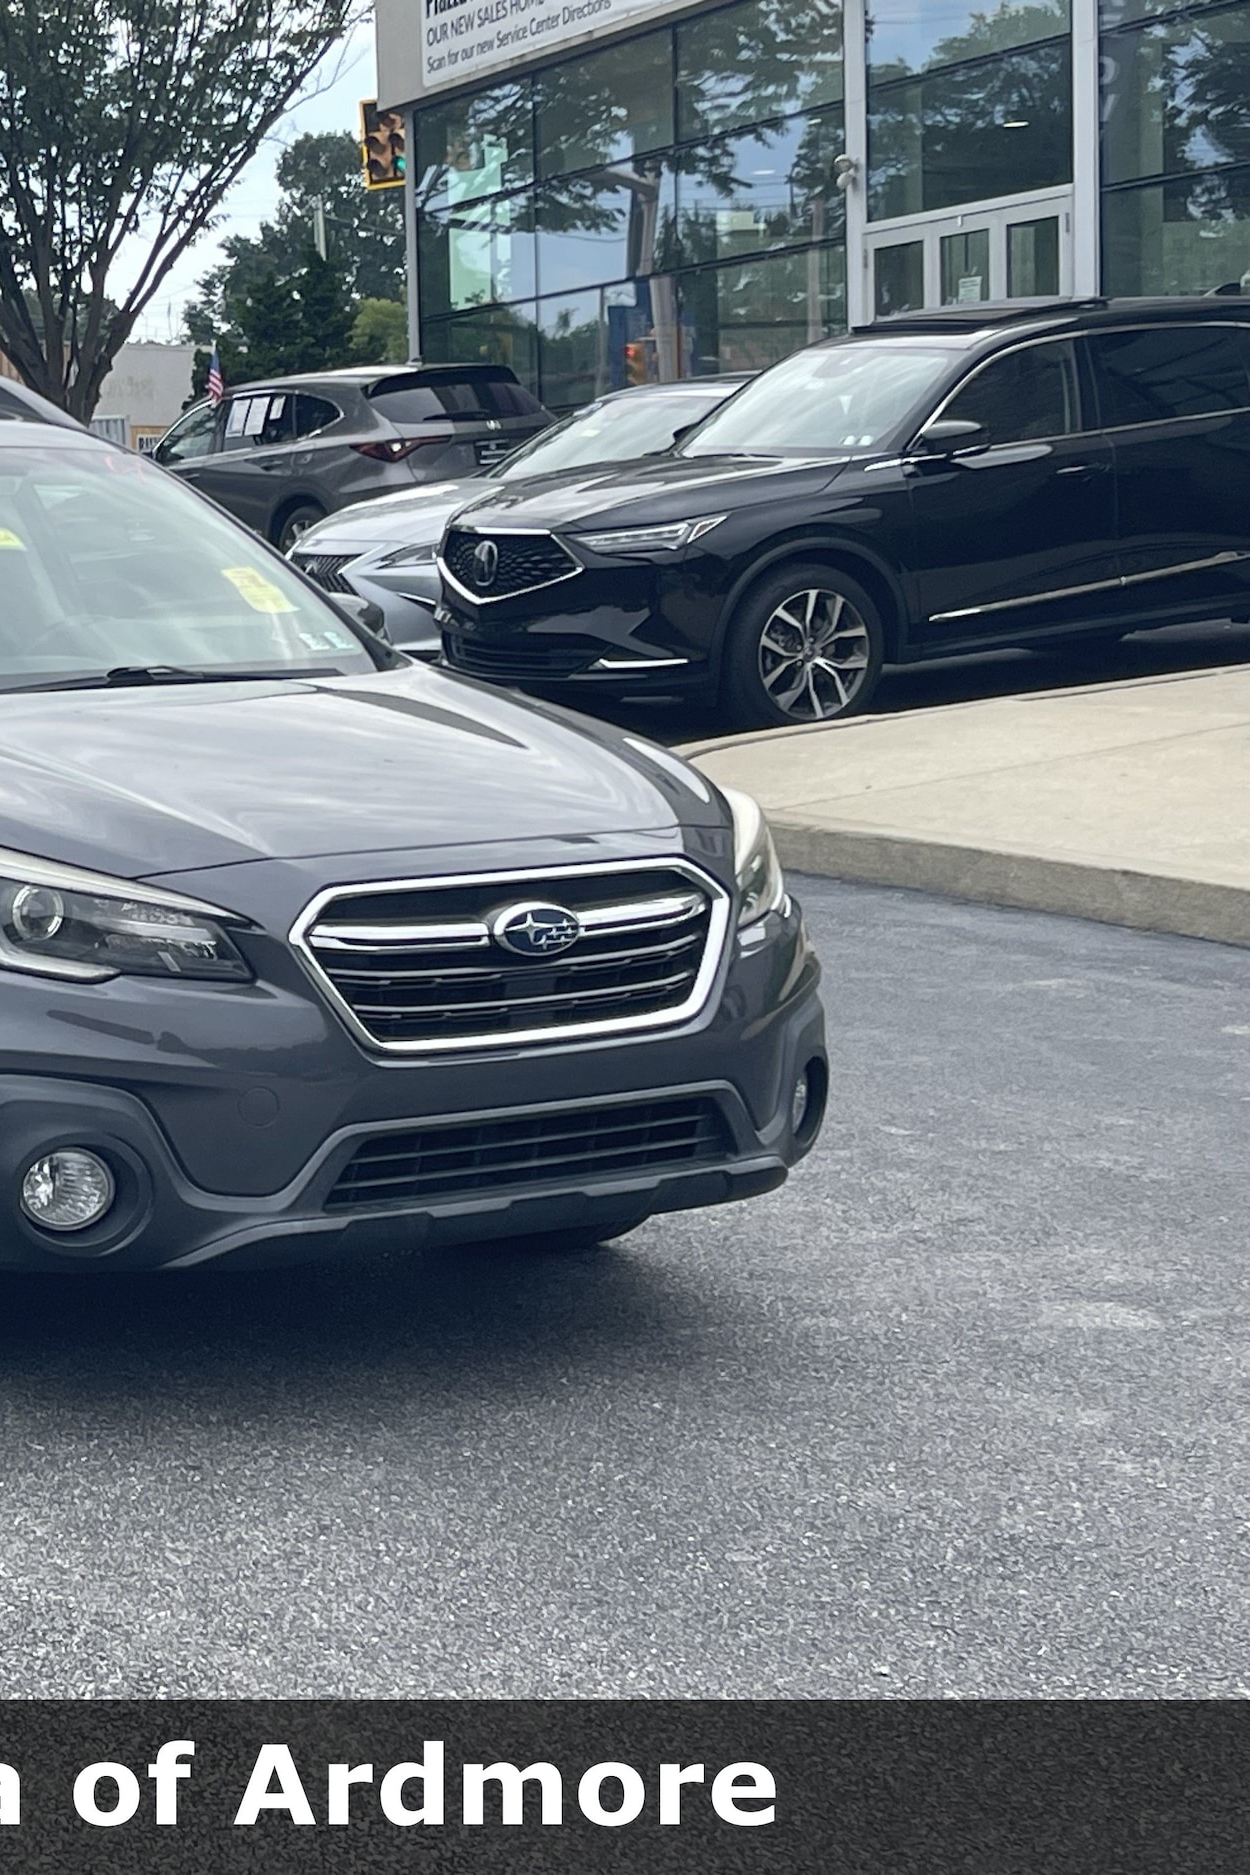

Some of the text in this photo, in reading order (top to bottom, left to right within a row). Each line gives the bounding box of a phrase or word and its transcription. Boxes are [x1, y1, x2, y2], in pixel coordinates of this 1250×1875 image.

[425, 0, 467, 19] Pia
[426, 0, 545, 47] OUR NEW SALES HO
[426, 55, 447, 74] Scan
[447, 49, 460, 65] for
[461, 45, 476, 61] our
[476, 38, 495, 56] new
[496, 24, 528, 49] Service
[529, 14, 561, 36] Center
